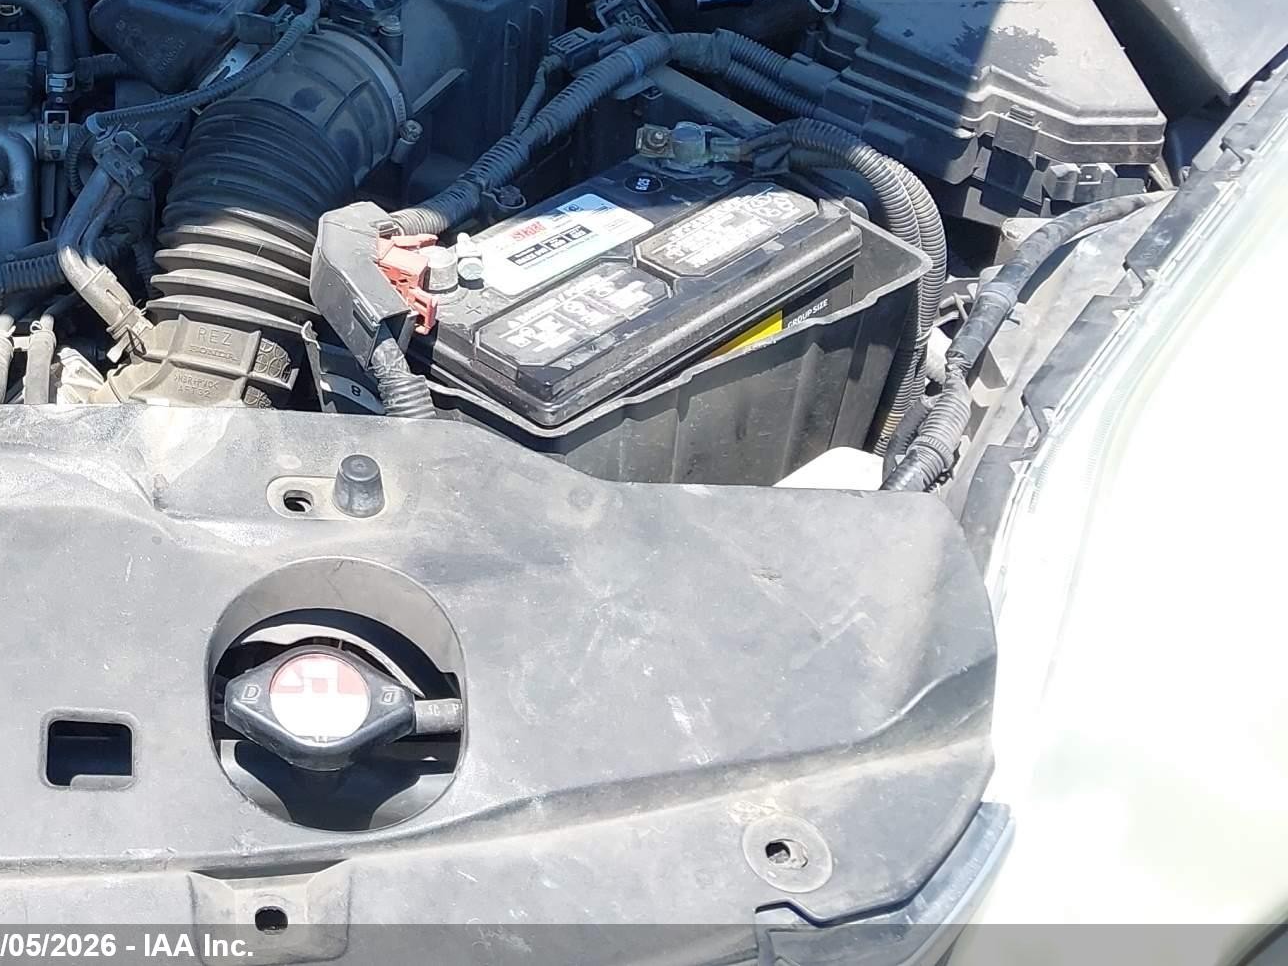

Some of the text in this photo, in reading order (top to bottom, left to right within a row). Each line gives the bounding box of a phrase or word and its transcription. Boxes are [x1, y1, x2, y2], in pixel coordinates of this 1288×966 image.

[787, 298, 829, 328] GROUP SIZE
[198, 327, 233, 347] REZ
